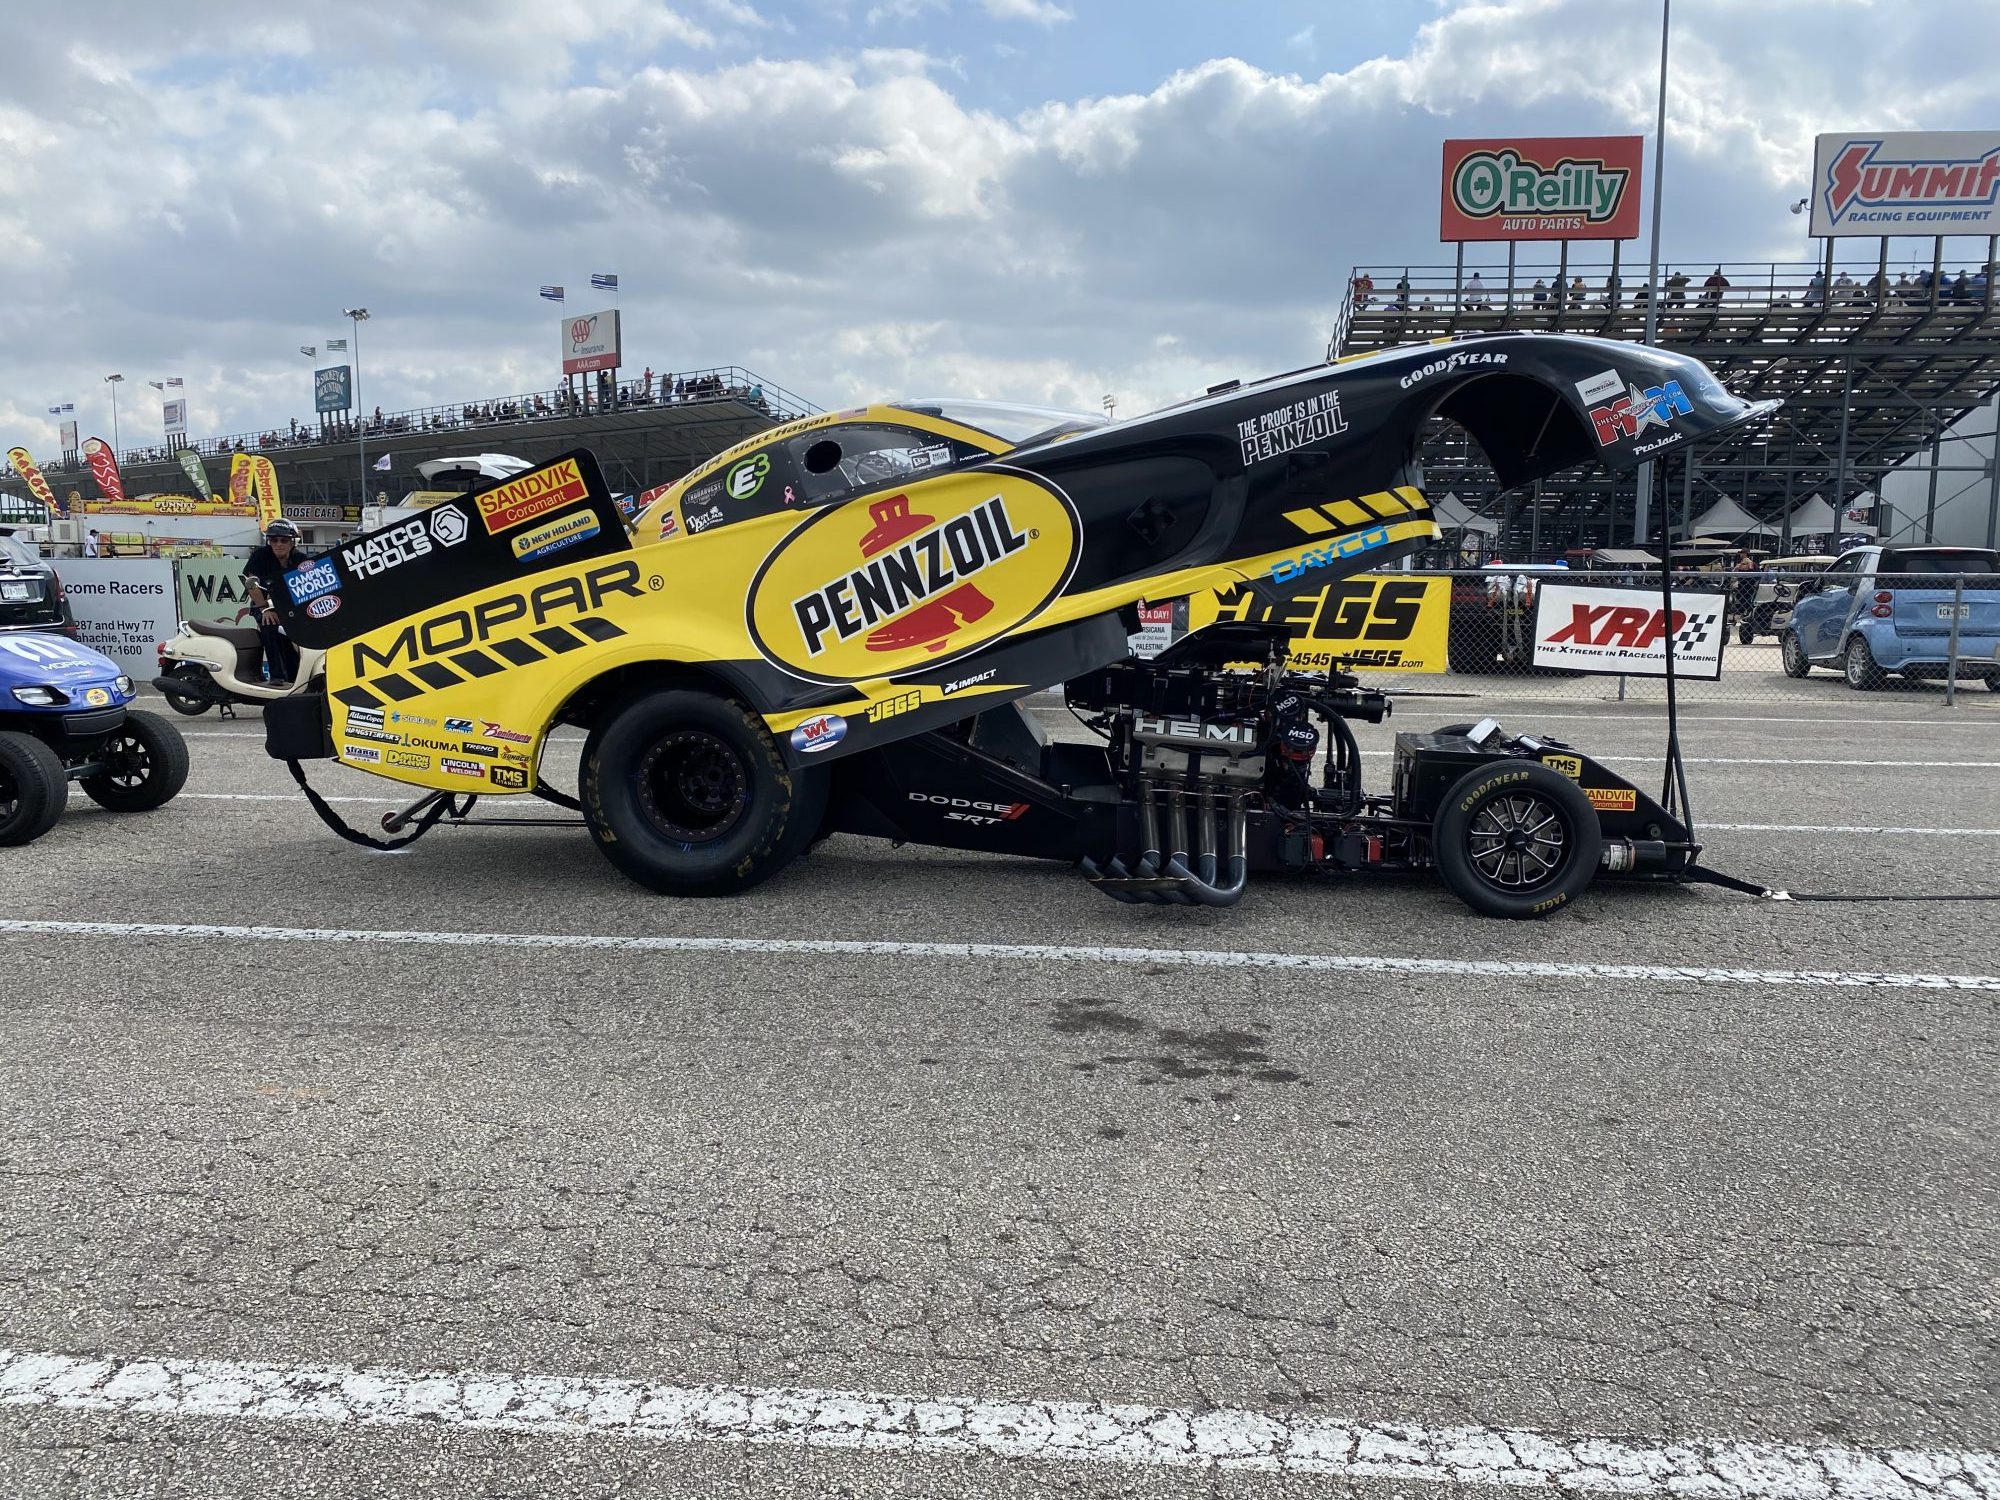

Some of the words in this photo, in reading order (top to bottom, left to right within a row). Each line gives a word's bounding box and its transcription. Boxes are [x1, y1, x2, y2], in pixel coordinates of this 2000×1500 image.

[1461, 158, 1618, 213] O'Reilly
[1502, 219, 1536, 230] AUTO
[1539, 218, 1582, 230] PARTS
[1848, 212, 1902, 222] RACING
[1906, 211, 1992, 222] EQUIPMENT
[577, 360, 601, 369] AAA.com
[1400, 352, 1508, 389] GOODYEAR
[1237, 418, 1258, 439] THE
[1260, 405, 1293, 431] PROOF
[1294, 401, 1306, 420] IS
[1307, 397, 1319, 415] IN
[1319, 390, 1340, 410] THE
[1596, 413, 1624, 427] SHELOR
[1240, 405, 1349, 466] PENNZOIL
[479, 461, 578, 514] SANDVIK
[155, 501, 196, 509] FUNNEL
[506, 490, 566, 521] Coromant
[314, 508, 337, 518] CAFE
[531, 531, 551, 545] NEW
[551, 515, 591, 537] HOLLAND
[342, 519, 426, 567] MATCO
[536, 532, 583, 555] AGRICULTURE
[348, 537, 433, 581] TOOLS
[1271, 525, 1390, 585] DAYCO
[288, 564, 333, 588] CAMPING
[792, 494, 1028, 658] PENNZOIL
[65, 584, 106, 595] come
[109, 581, 164, 595] Racers
[292, 574, 336, 598] WORLD
[312, 599, 337, 615] NHRA
[1153, 610, 1169, 619] DAY!
[95, 620, 115, 631] and
[117, 620, 140, 633] Hwy
[141, 620, 155, 630] 77
[352, 560, 647, 679] MOPAR
[1543, 603, 1687, 648] XRP
[77, 633, 121, 644] ahachie,
[122, 633, 155, 643] Texas
[95, 645, 142, 655] 517-1600
[1135, 643, 1164, 651] PALESTINE
[1536, 645, 1556, 654] THE
[1558, 645, 1604, 656] XTREME
[1618, 649, 1665, 660] RACECAR
[958, 668, 997, 690] IMPACT
[867, 690, 921, 724] JEGS
[1275, 695, 1297, 712] MSD
[349, 711, 366, 720] Atlas
[366, 714, 383, 723] Copco
[1134, 717, 1255, 744] HEMI
[1287, 729, 1314, 741] MSD
[411, 738, 460, 753] OKUMA
[465, 743, 495, 752] TREND
[442, 758, 478, 770] LINCOLN
[502, 752, 531, 763] SUNOCO
[1547, 759, 1577, 771] TMS
[450, 767, 481, 777] WELDERS
[494, 768, 523, 783] TMS
[495, 779, 523, 787] TITANIUM
[1460, 771, 1529, 812] GOODYEAR
[908, 792, 1012, 814] DODGE
[943, 812, 1003, 826] SRT
[1532, 892, 1567, 913] EAGLE
